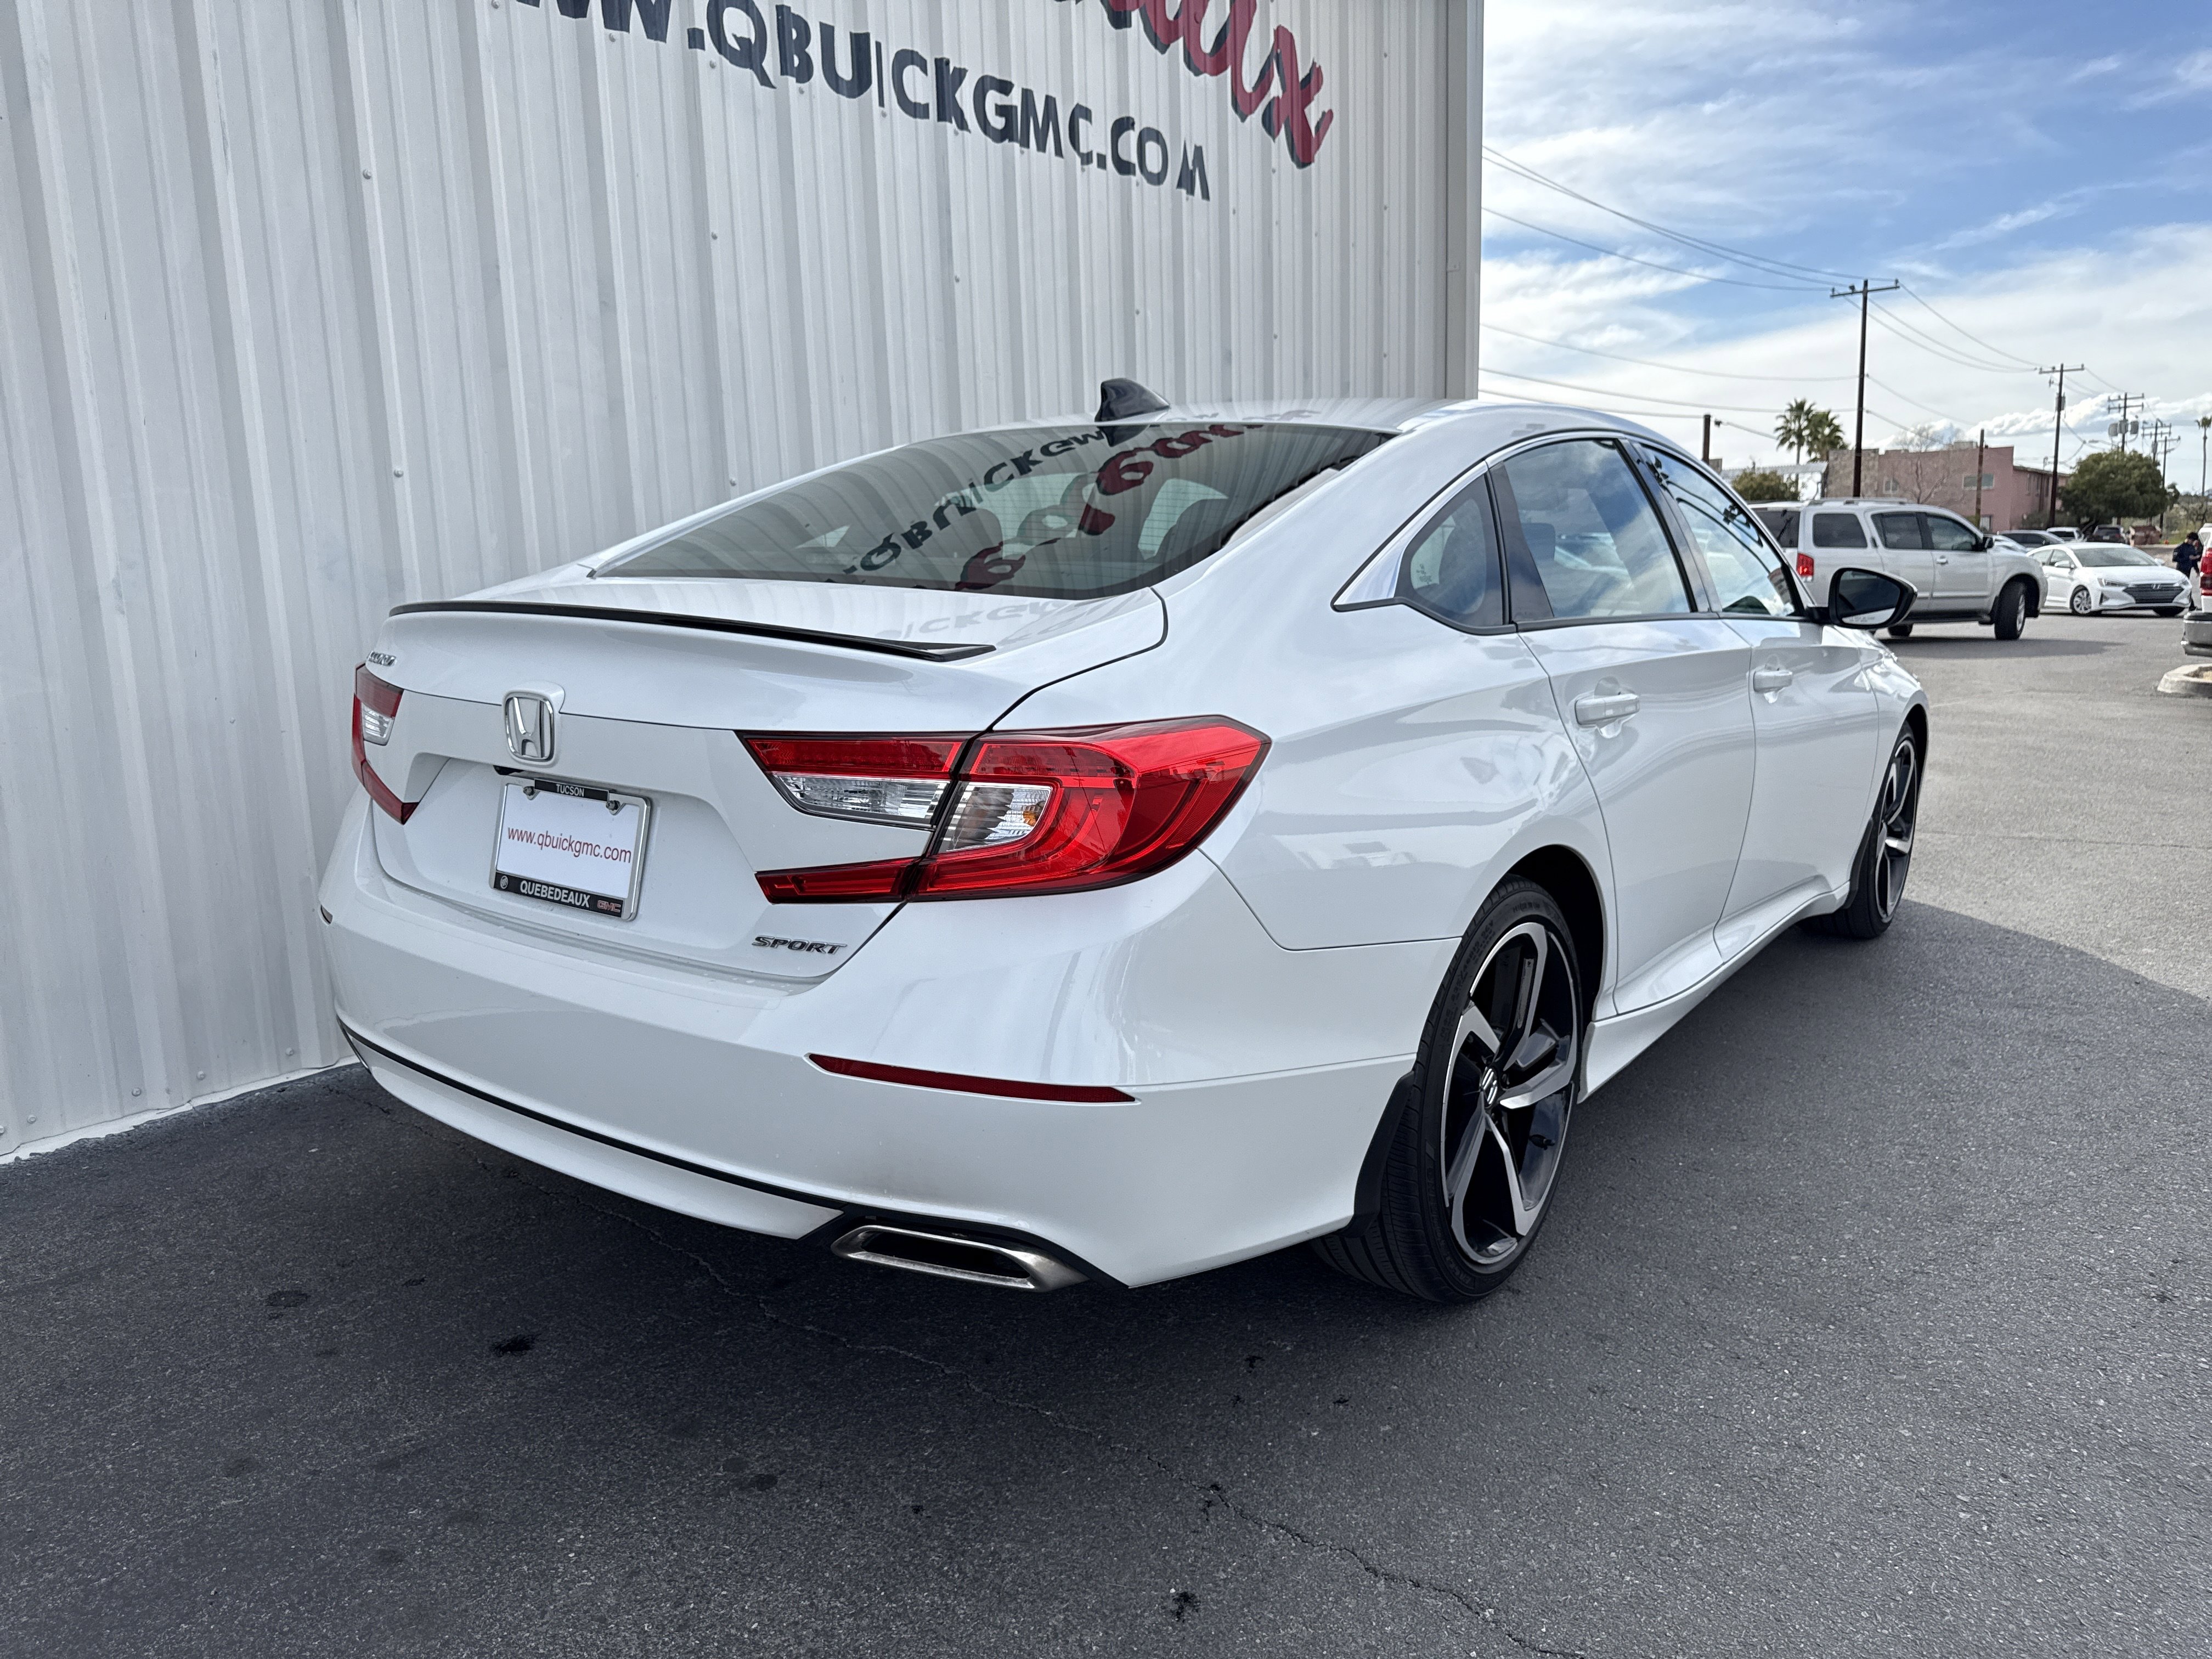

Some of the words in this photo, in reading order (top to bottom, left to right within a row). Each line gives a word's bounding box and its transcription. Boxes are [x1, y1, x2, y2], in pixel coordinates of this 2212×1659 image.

[556, 783, 585, 797] TUCSON
[507, 827, 631, 864] www.qbuickgmc.com
[520, 880, 591, 908] QUEBEDEAUX
[597, 900, 622, 913] GMC
[752, 934, 848, 955] SPORT
